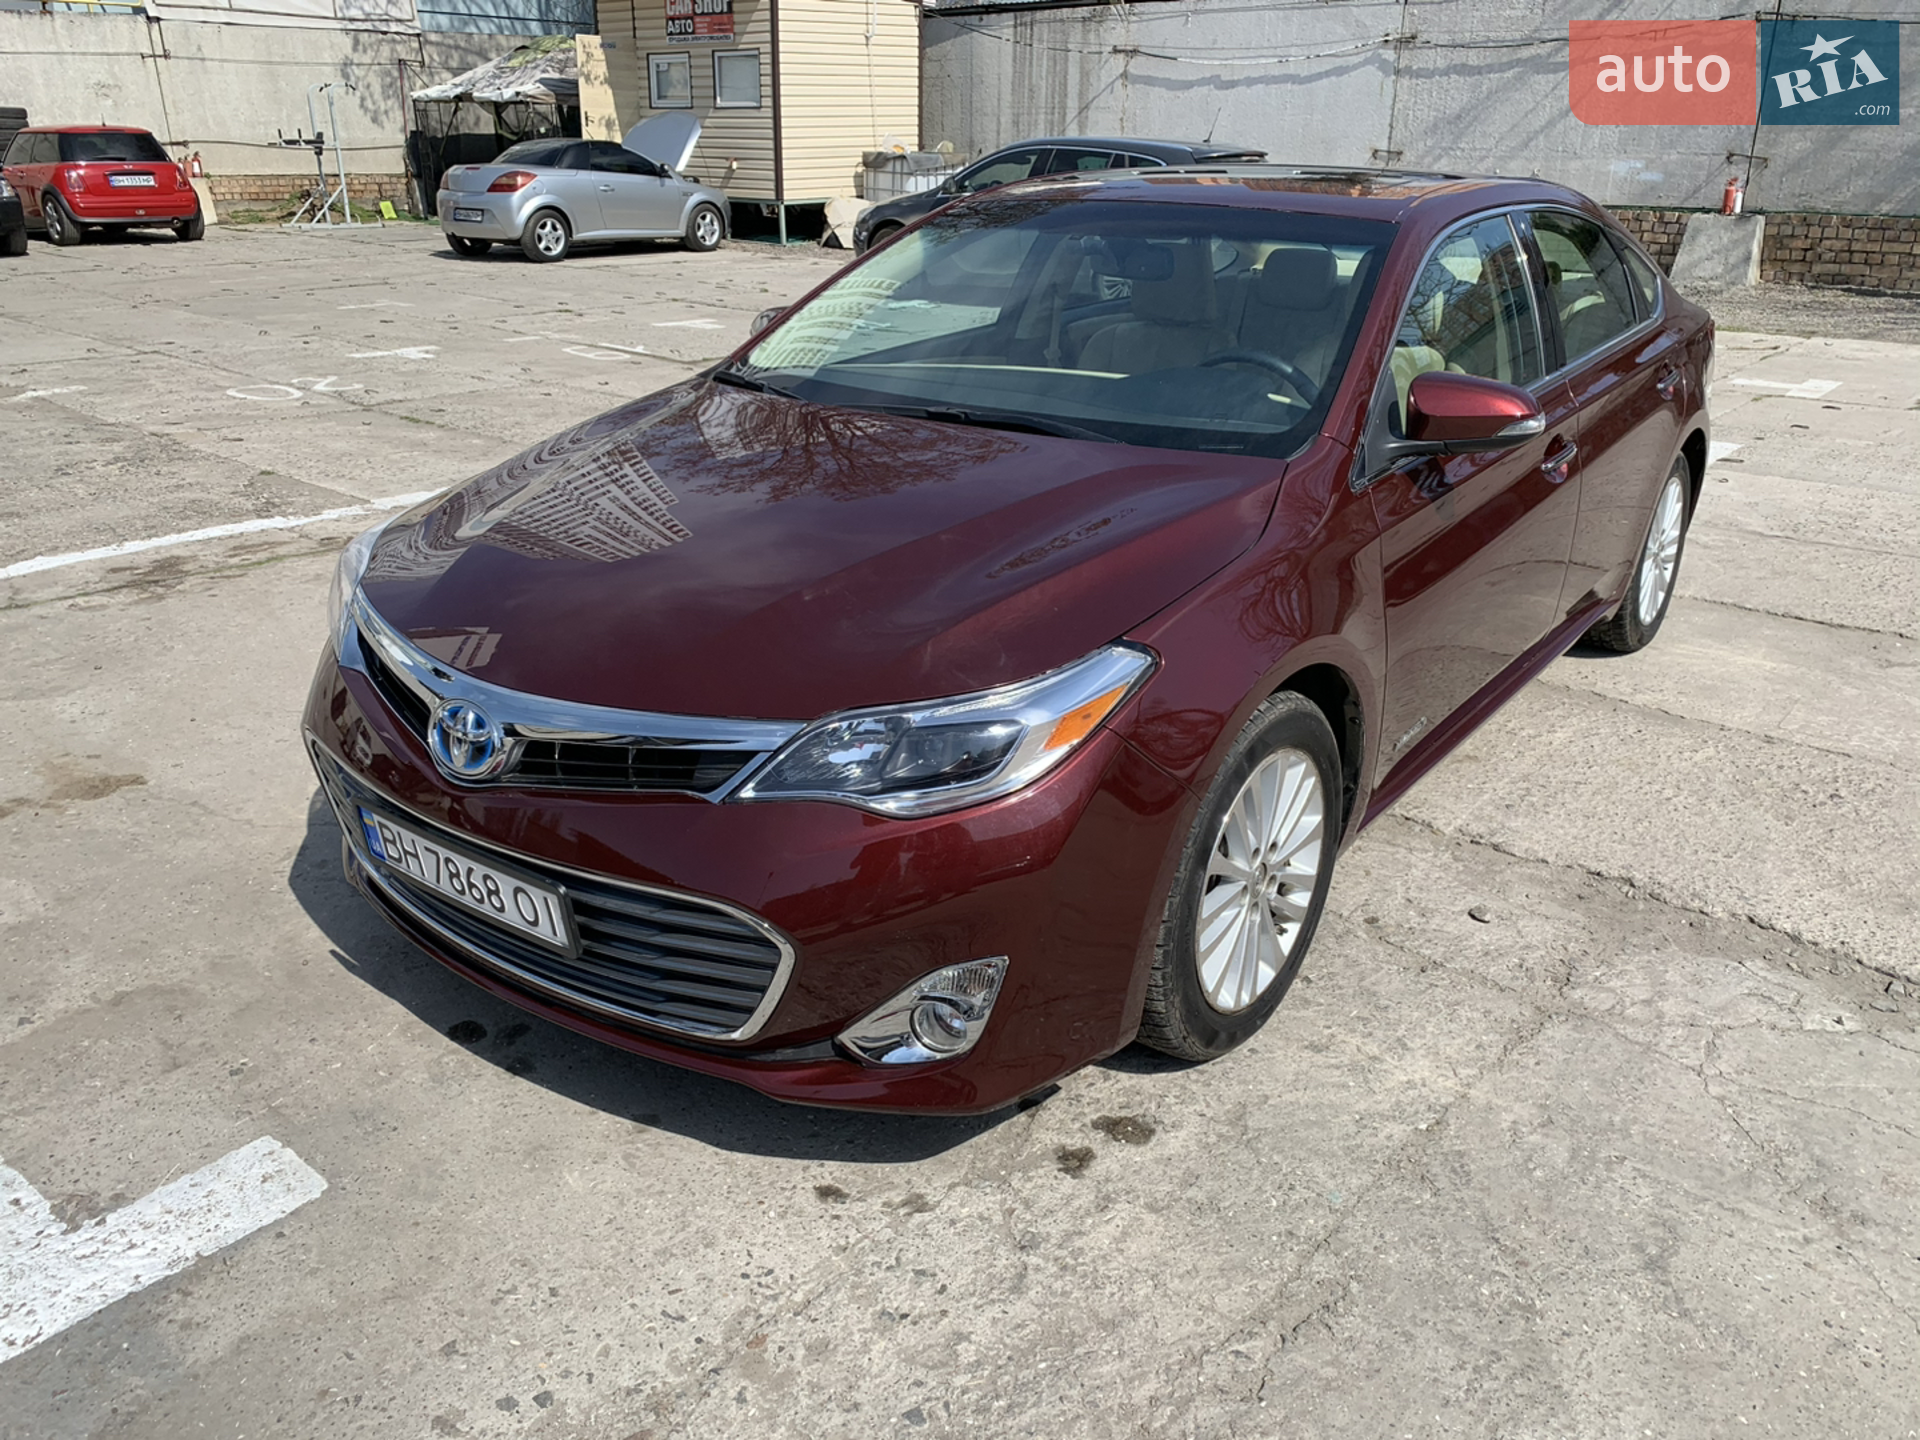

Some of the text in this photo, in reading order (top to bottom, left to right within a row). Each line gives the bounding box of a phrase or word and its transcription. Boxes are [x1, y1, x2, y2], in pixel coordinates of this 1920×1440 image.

[667, 0, 730, 15] CAR SHOP
[667, 19, 693, 34] АВТО
